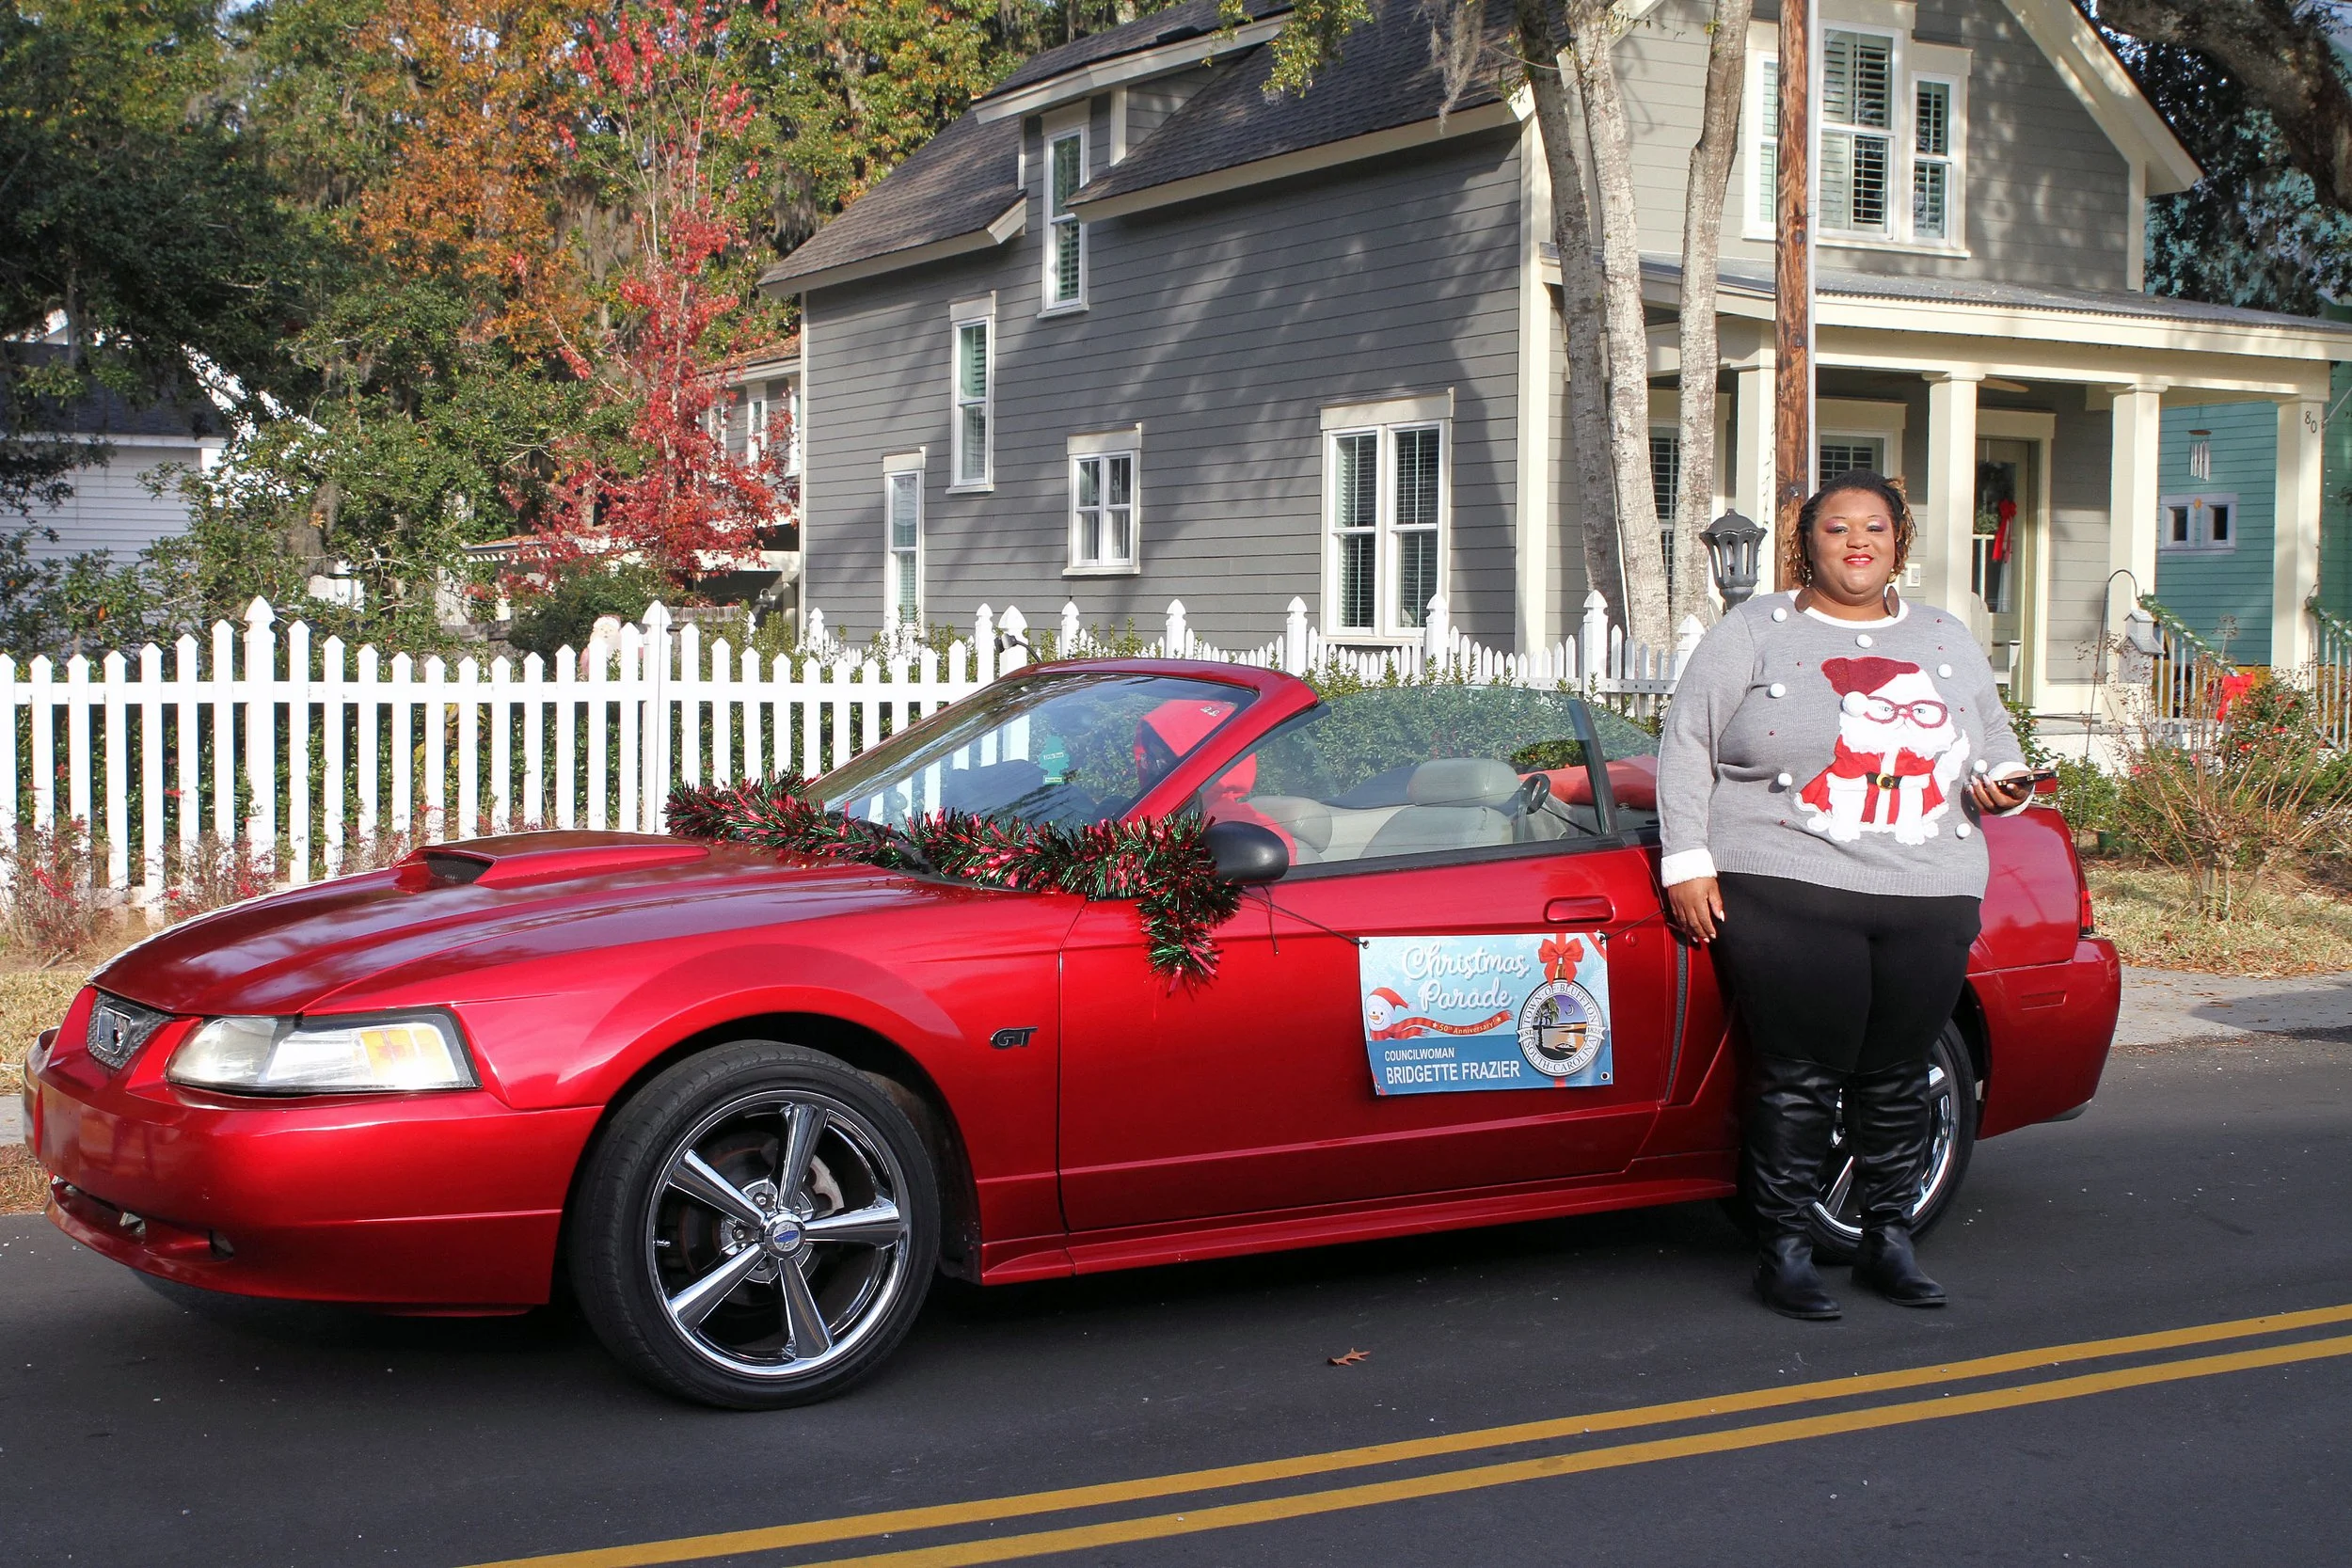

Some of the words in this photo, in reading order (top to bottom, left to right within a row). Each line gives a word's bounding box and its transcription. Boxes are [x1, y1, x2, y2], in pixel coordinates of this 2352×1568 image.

[2305, 410, 2317, 434] 80
[1402, 941, 1530, 979] Christmas
[1418, 977, 1514, 1013] Parade
[1524, 996, 1543, 1023] TOWN
[1560, 985, 1598, 1023] BLUFFTON
[990, 1026, 1039, 1050] GT
[1453, 1019, 1496, 1035] Anniversary!
[1385, 1047, 1454, 1062] COUNCILWOMAN
[1525, 1040, 1549, 1070] SOUTH
[1553, 1038, 1597, 1072] CAROLINA
[1386, 1063, 1458, 1085] BRIDGETTE
[1461, 1060, 1520, 1080] FRAZIER
